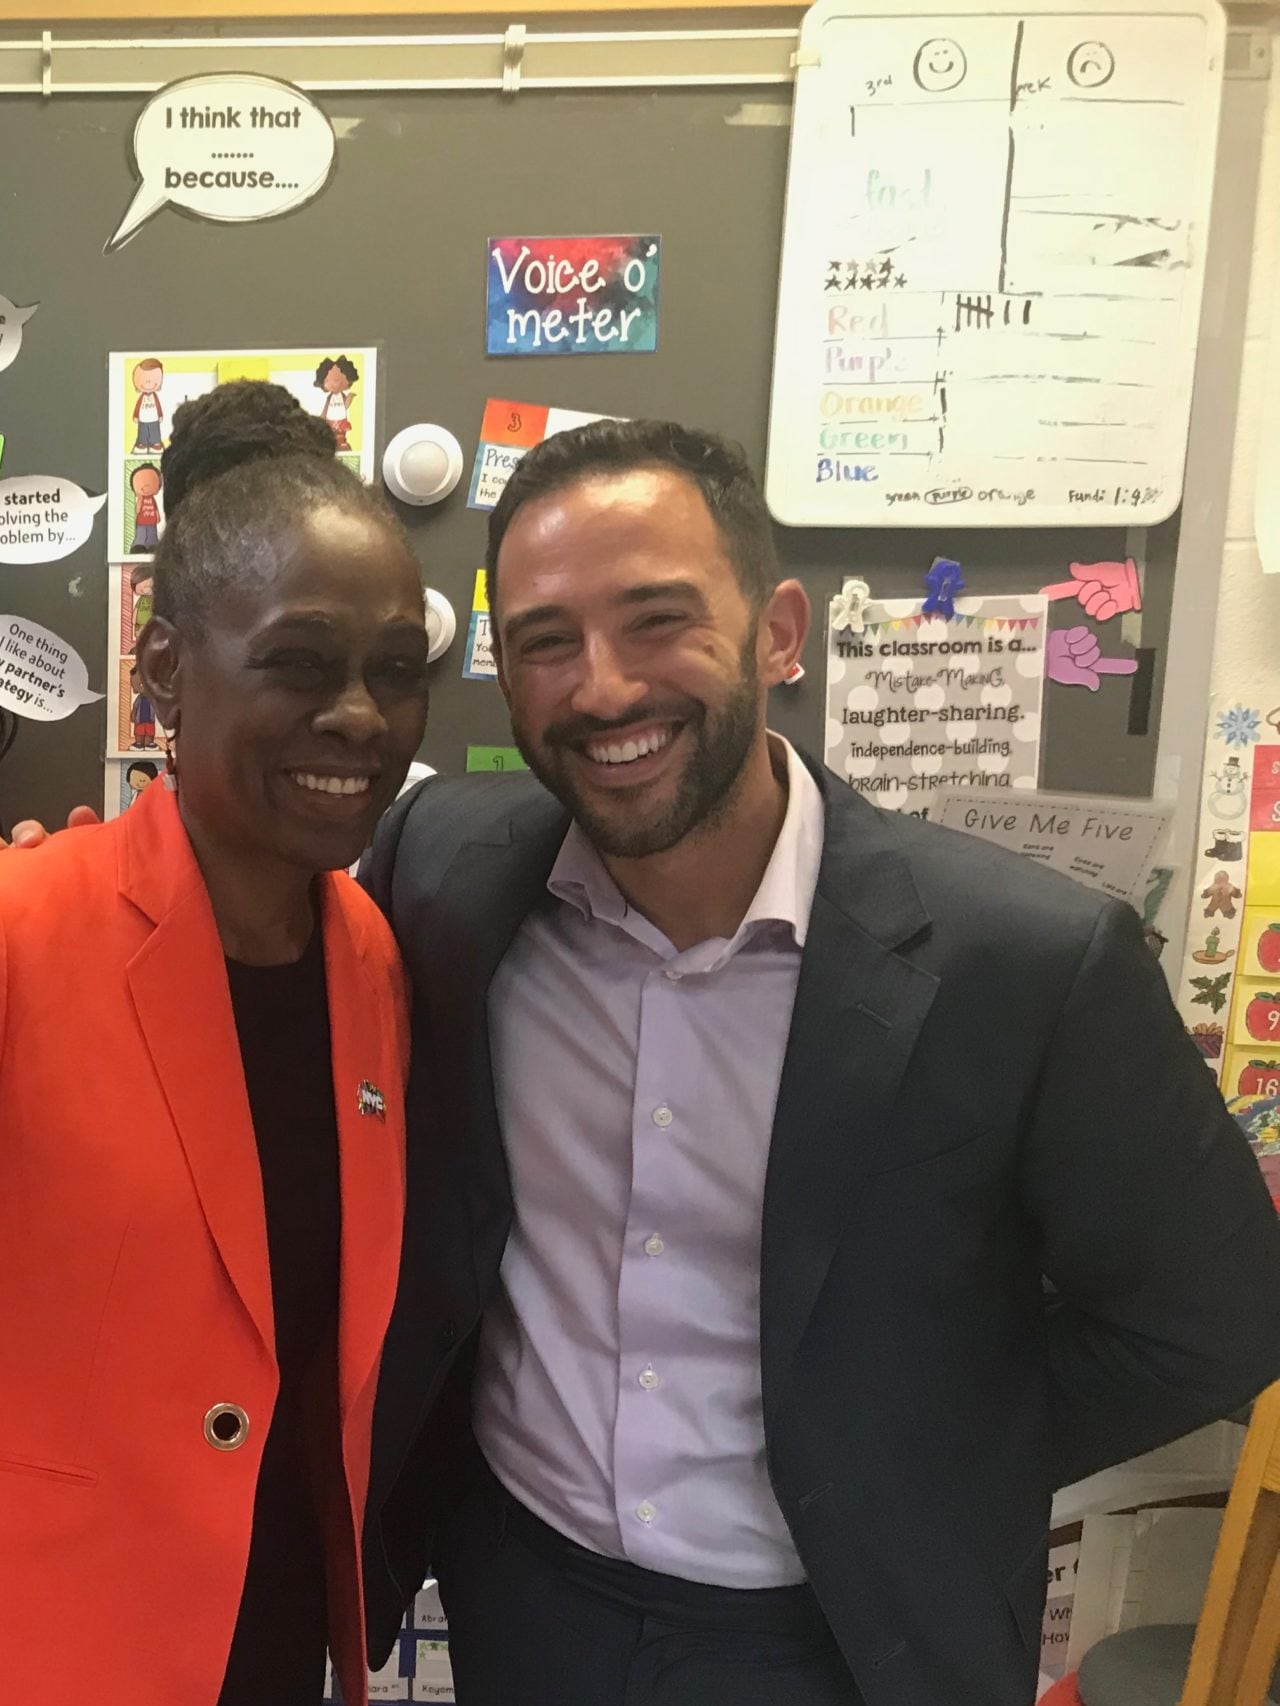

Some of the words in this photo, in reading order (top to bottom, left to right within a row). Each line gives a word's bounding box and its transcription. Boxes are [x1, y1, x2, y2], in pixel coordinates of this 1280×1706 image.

[865, 74, 893, 97] 3rd
[166, 107, 172, 128] I
[179, 106, 241, 128] think
[249, 106, 301, 128] that
[492, 245, 607, 294] Voice
[506, 297, 642, 347] meter
[827, 303, 888, 336] Red
[507, 412, 522, 432] 3
[819, 427, 908, 450] Green
[816, 457, 879, 483] Blue
[4, 488, 61, 506] started
[45, 508, 69, 523] the
[9, 623, 34, 645] One
[35, 636, 69, 665] thing
[837, 641, 873, 658] This
[879, 640, 983, 656] classroom
[988, 637, 1003, 652] is
[1008, 638, 1037, 653] a...
[4, 638, 28, 660] like
[28, 654, 67, 680] about
[4, 661, 66, 699] partner's
[964, 808, 1017, 831] Give
[1029, 813, 1070, 835] Me
[1081, 817, 1133, 841] Five
